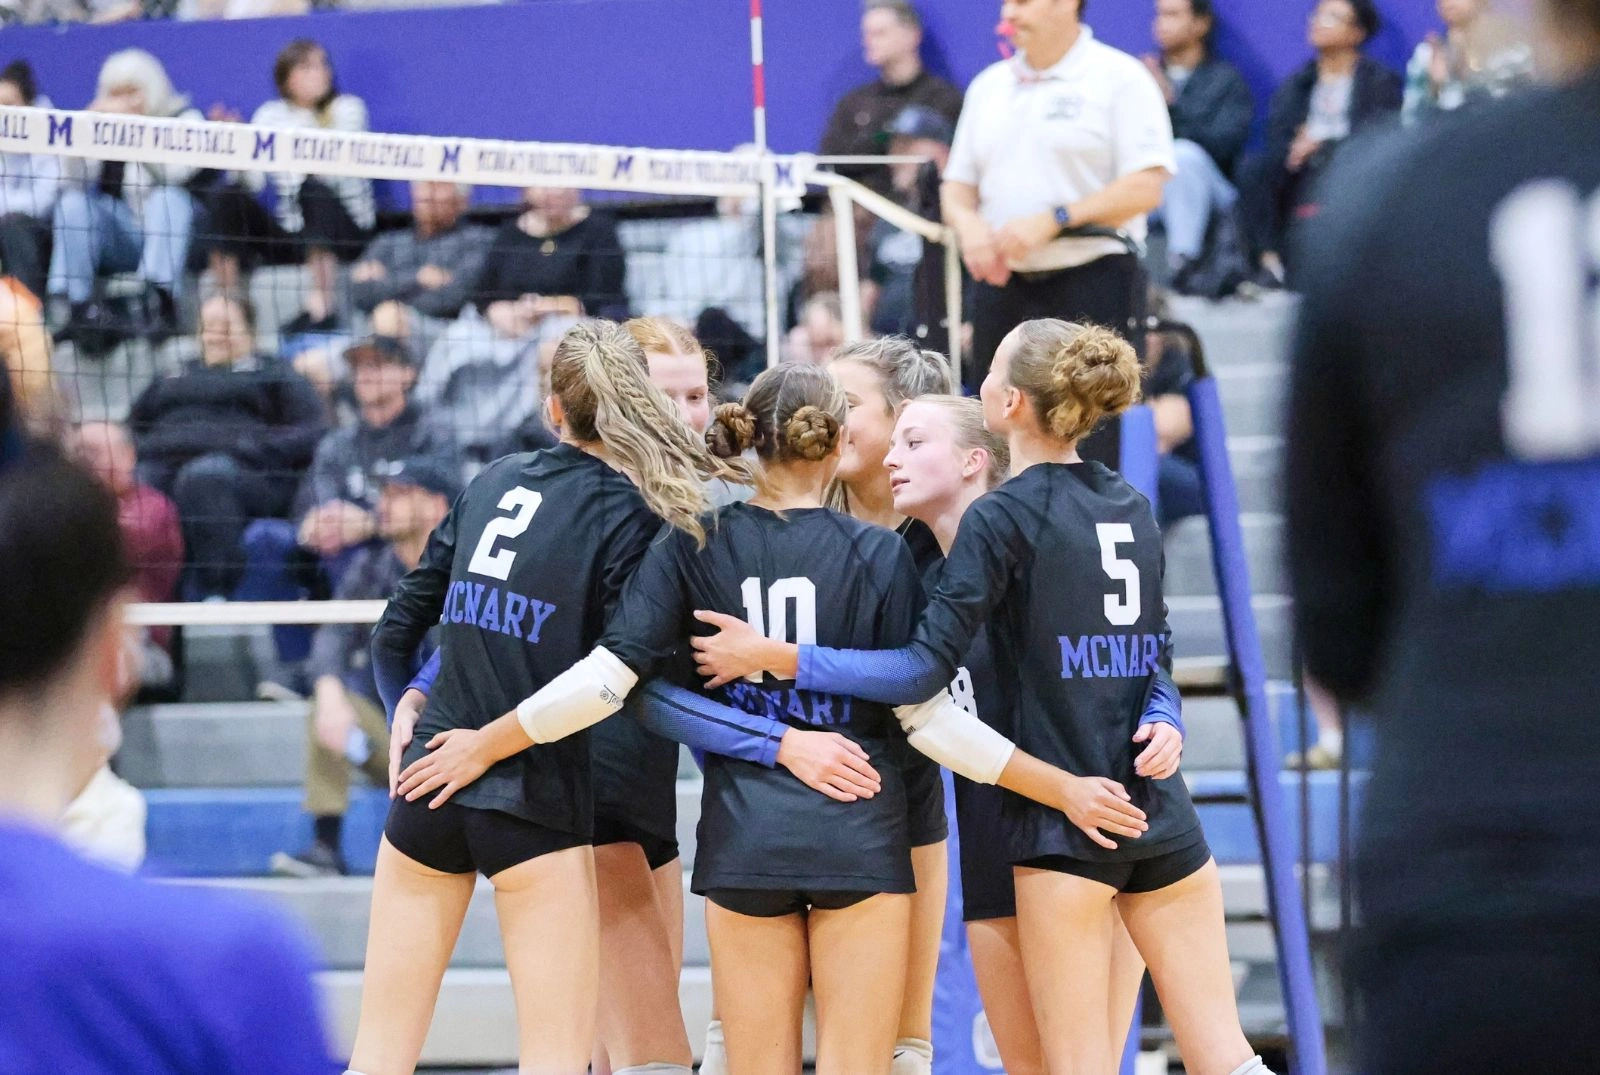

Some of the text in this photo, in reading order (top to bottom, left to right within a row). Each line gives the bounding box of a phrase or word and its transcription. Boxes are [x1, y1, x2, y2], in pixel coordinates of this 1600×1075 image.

[48, 114, 73, 146] M
[252, 131, 276, 162] M
[440, 143, 461, 173] M
[612, 154, 634, 182] M
[1489, 178, 1600, 462] 1
[467, 485, 543, 581] 2
[1095, 523, 1141, 626] 5
[741, 577, 817, 683] 10
